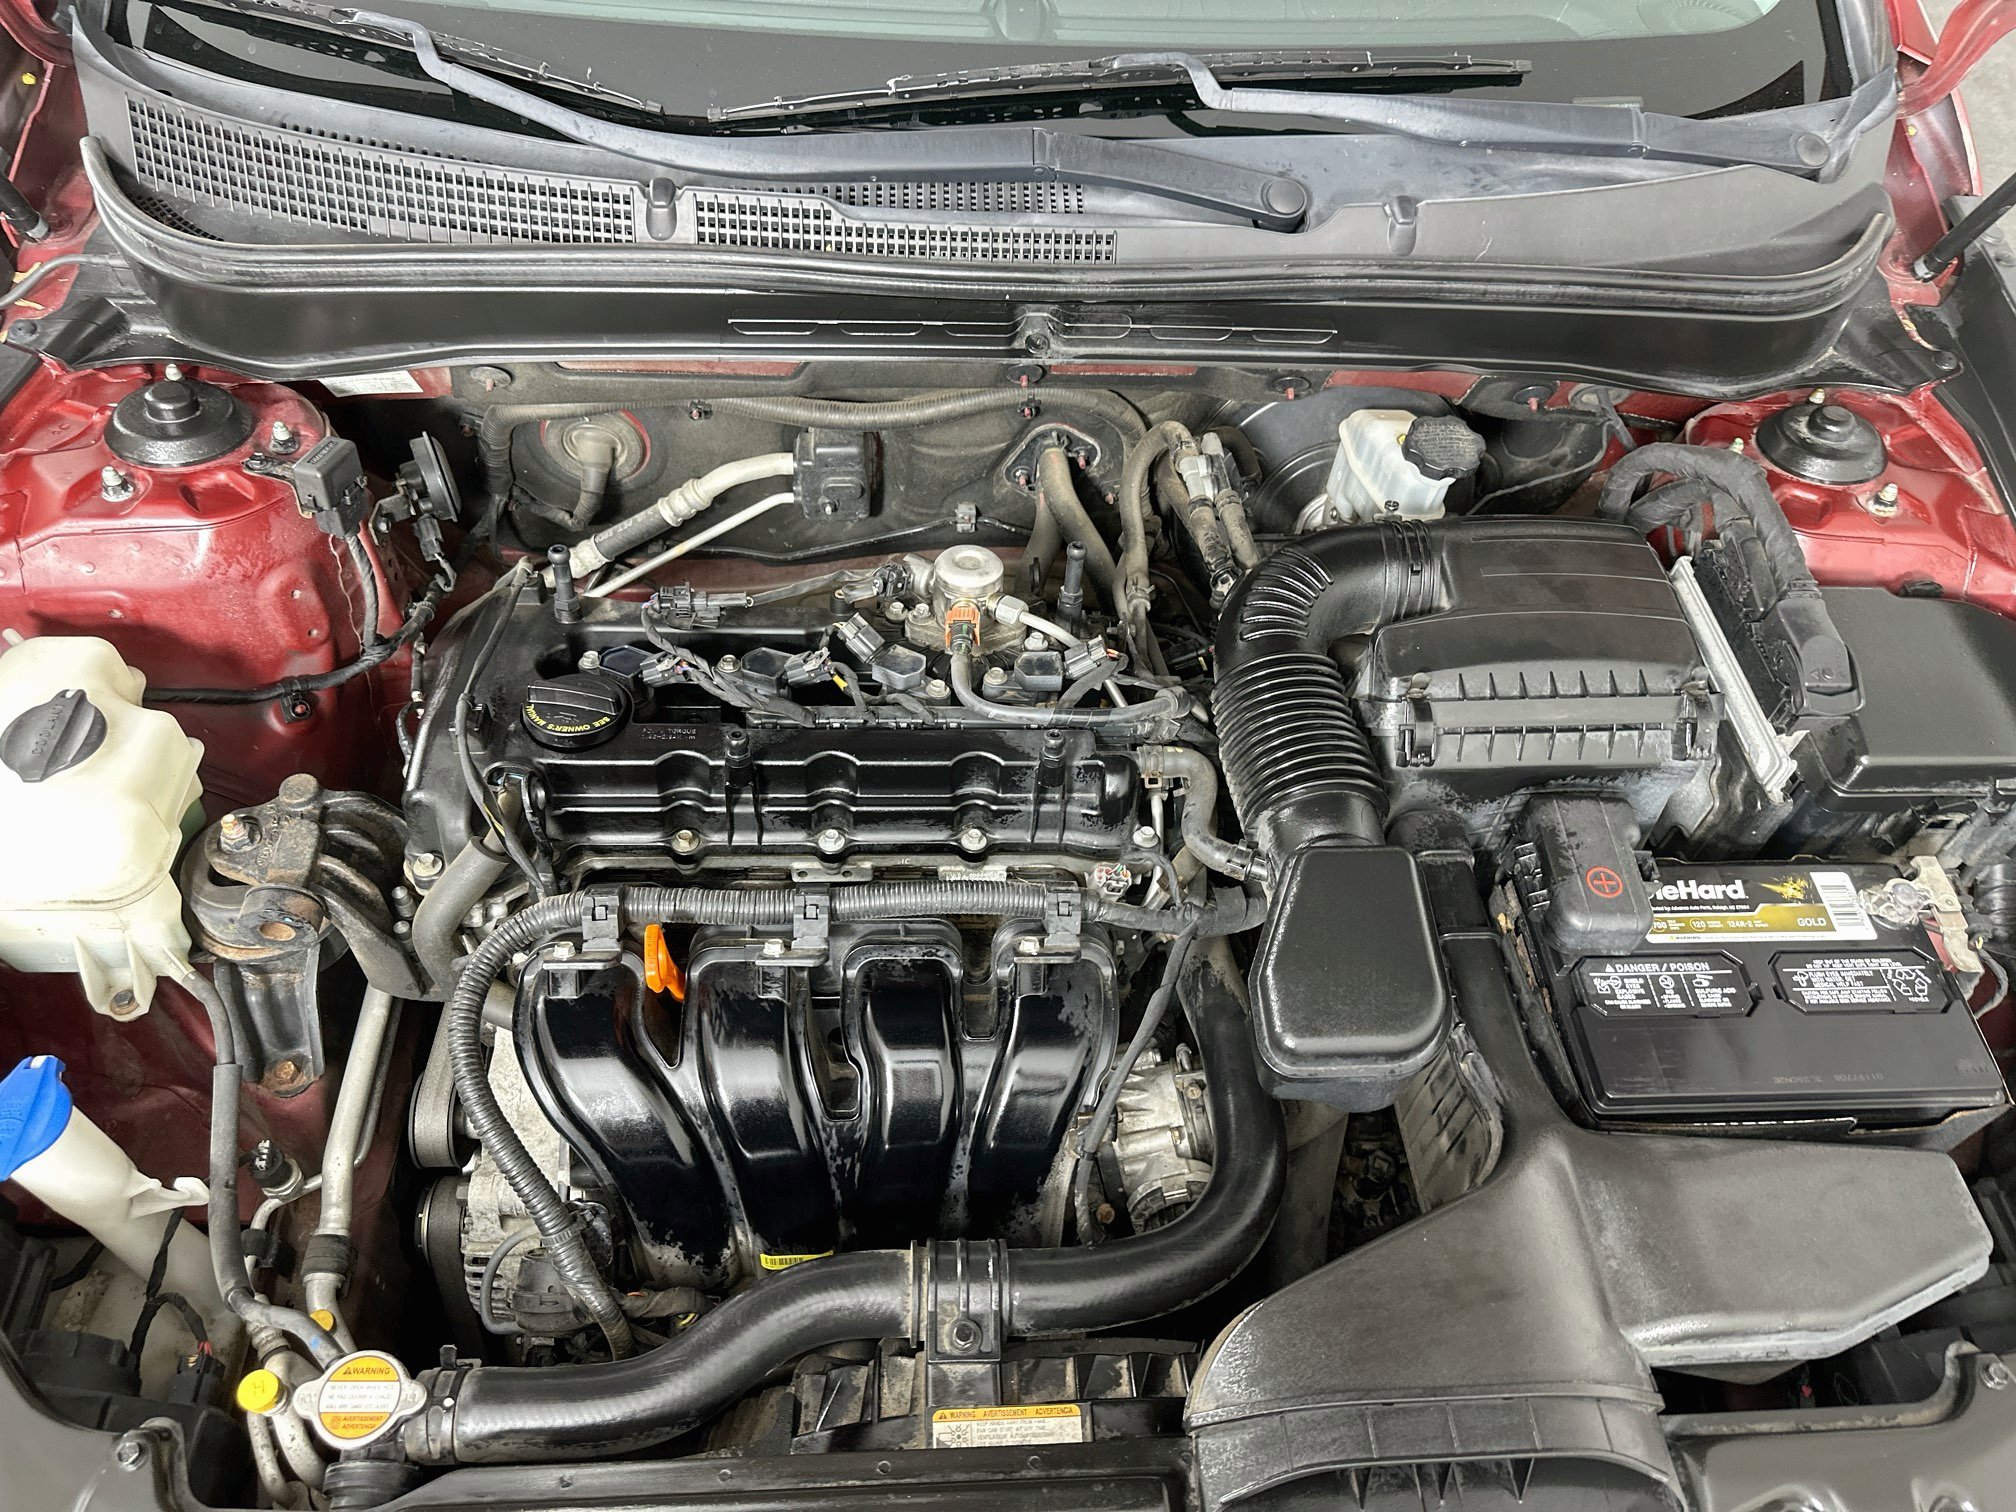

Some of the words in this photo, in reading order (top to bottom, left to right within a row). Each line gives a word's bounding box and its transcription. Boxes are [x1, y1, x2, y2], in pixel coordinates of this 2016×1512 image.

[526, 704, 547, 726] MANUAL
[546, 723, 590, 732] OWNER'S
[592, 716, 610, 728] SEE
[32, 704, 64, 756] COOLANT
[1797, 918, 1827, 927] GOLD
[1615, 963, 1660, 972] DANGER
[1661, 963, 1667, 971] /
[1670, 962, 1710, 972] POISON
[253, 1380, 265, 1395] H
[983, 1409, 1027, 1417] AVERTISSEMENT
[1035, 1407, 1073, 1415] ADVERTENCIA
